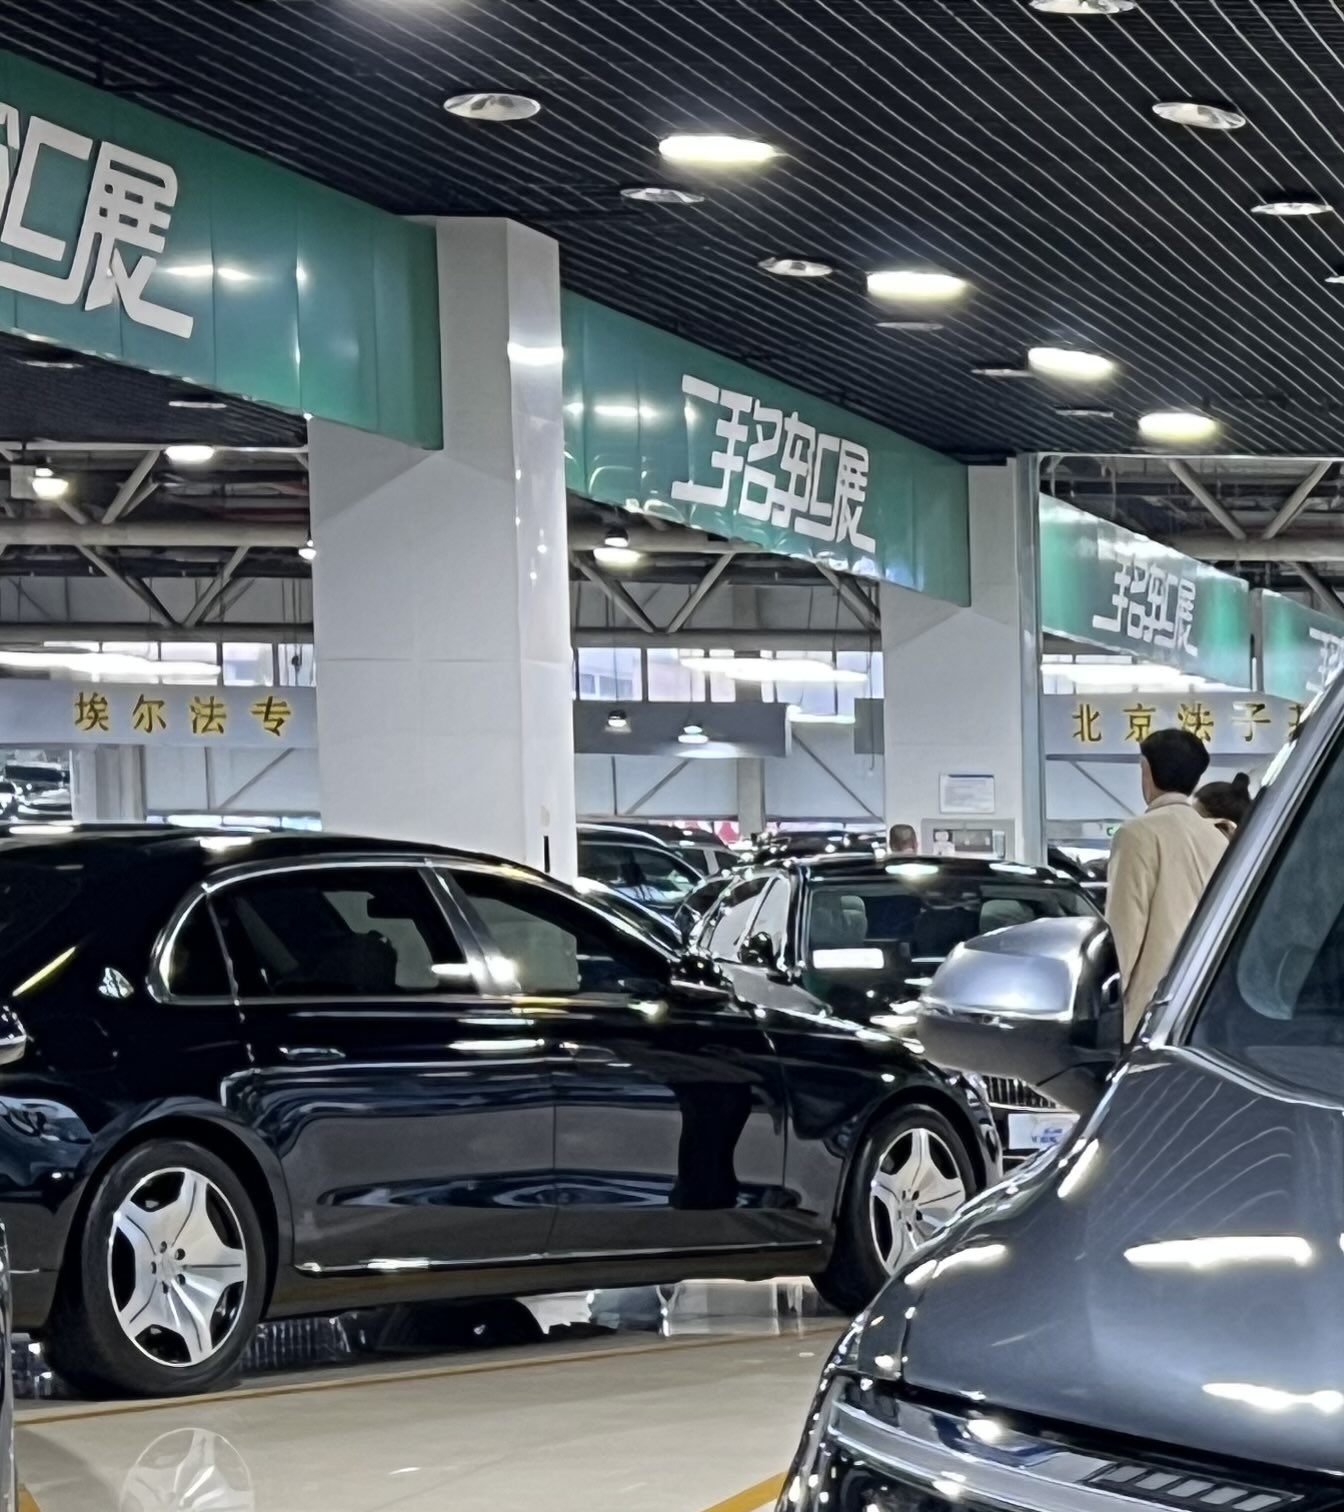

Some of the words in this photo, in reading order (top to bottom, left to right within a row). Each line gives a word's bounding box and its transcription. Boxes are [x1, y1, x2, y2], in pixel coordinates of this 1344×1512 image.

[0, 102, 194, 340] 汇展
[74, 691, 292, 737] 埃尔法专
